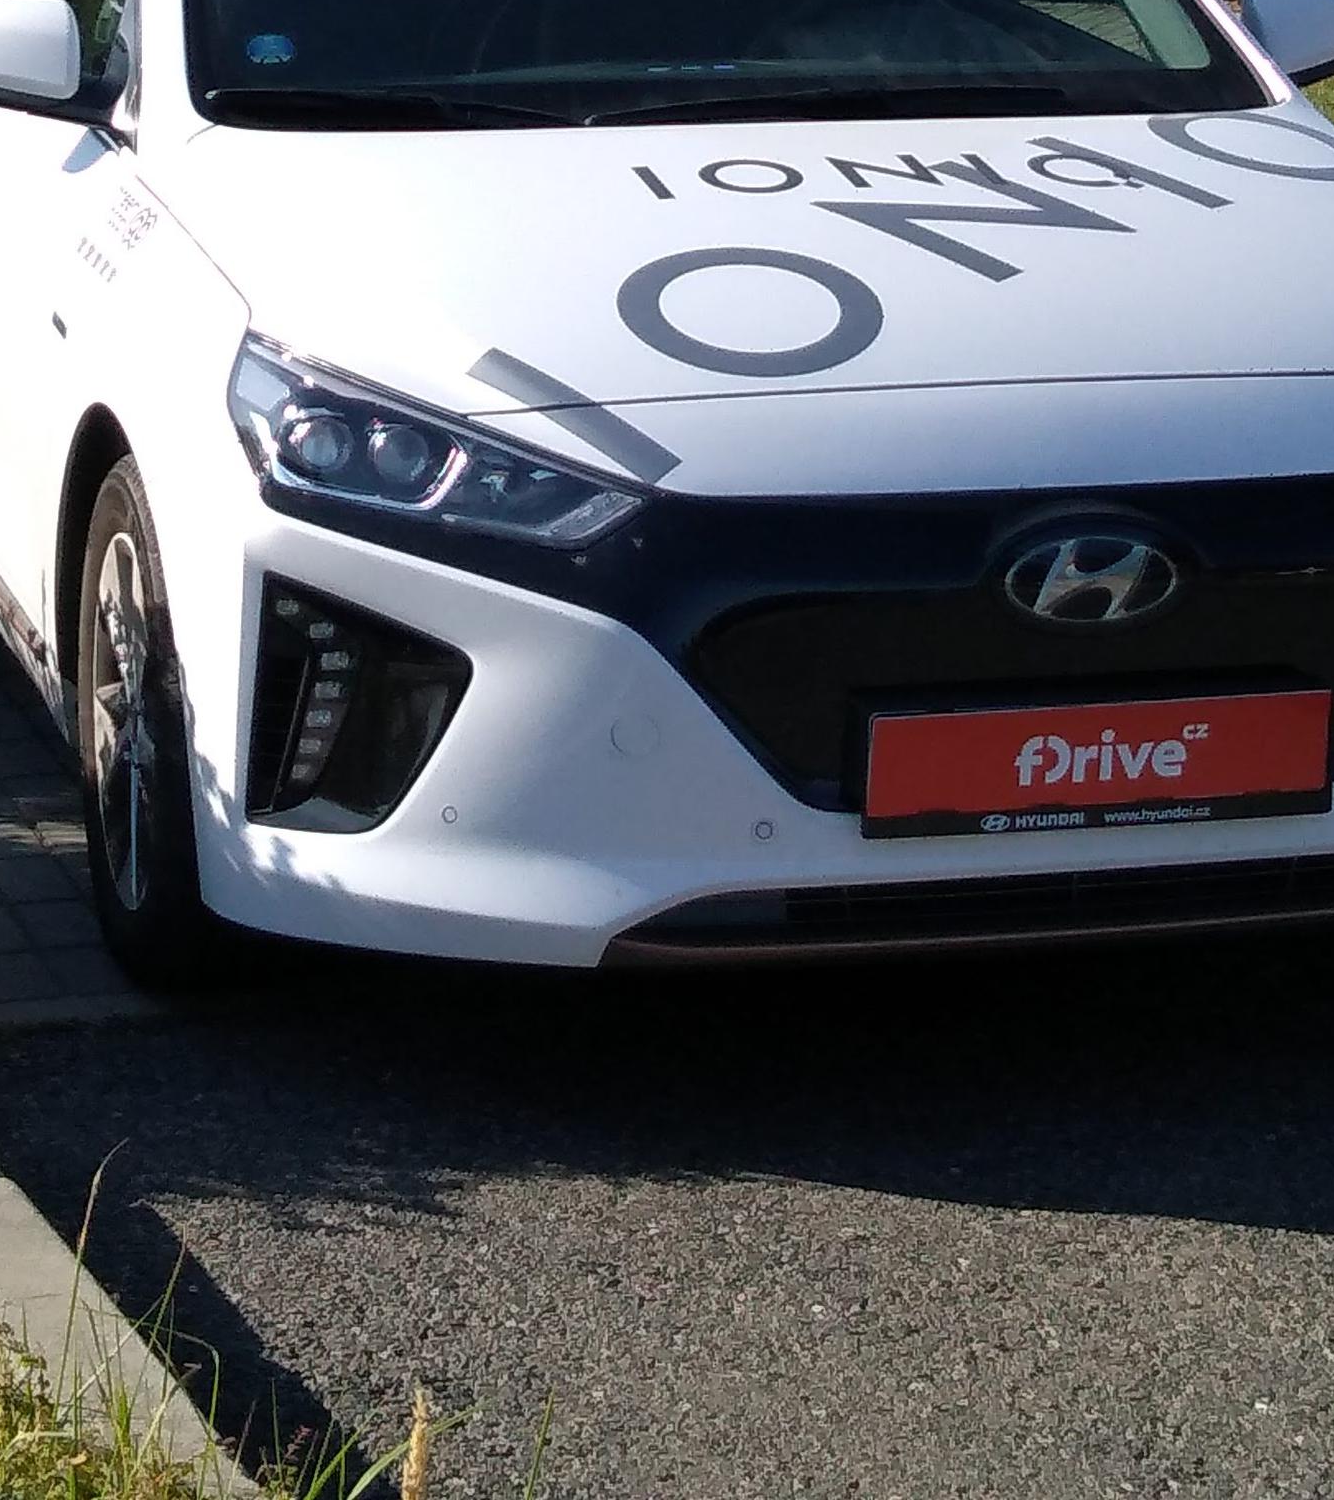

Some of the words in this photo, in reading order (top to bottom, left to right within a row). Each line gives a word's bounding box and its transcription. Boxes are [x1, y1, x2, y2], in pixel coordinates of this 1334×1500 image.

[631, 153, 1144, 201] IONIQ
[1014, 729, 1187, 787] fDrive
[1015, 812, 1085, 828] HYUNDAI
[1104, 805, 1211, 823] www.hyundai.cz
